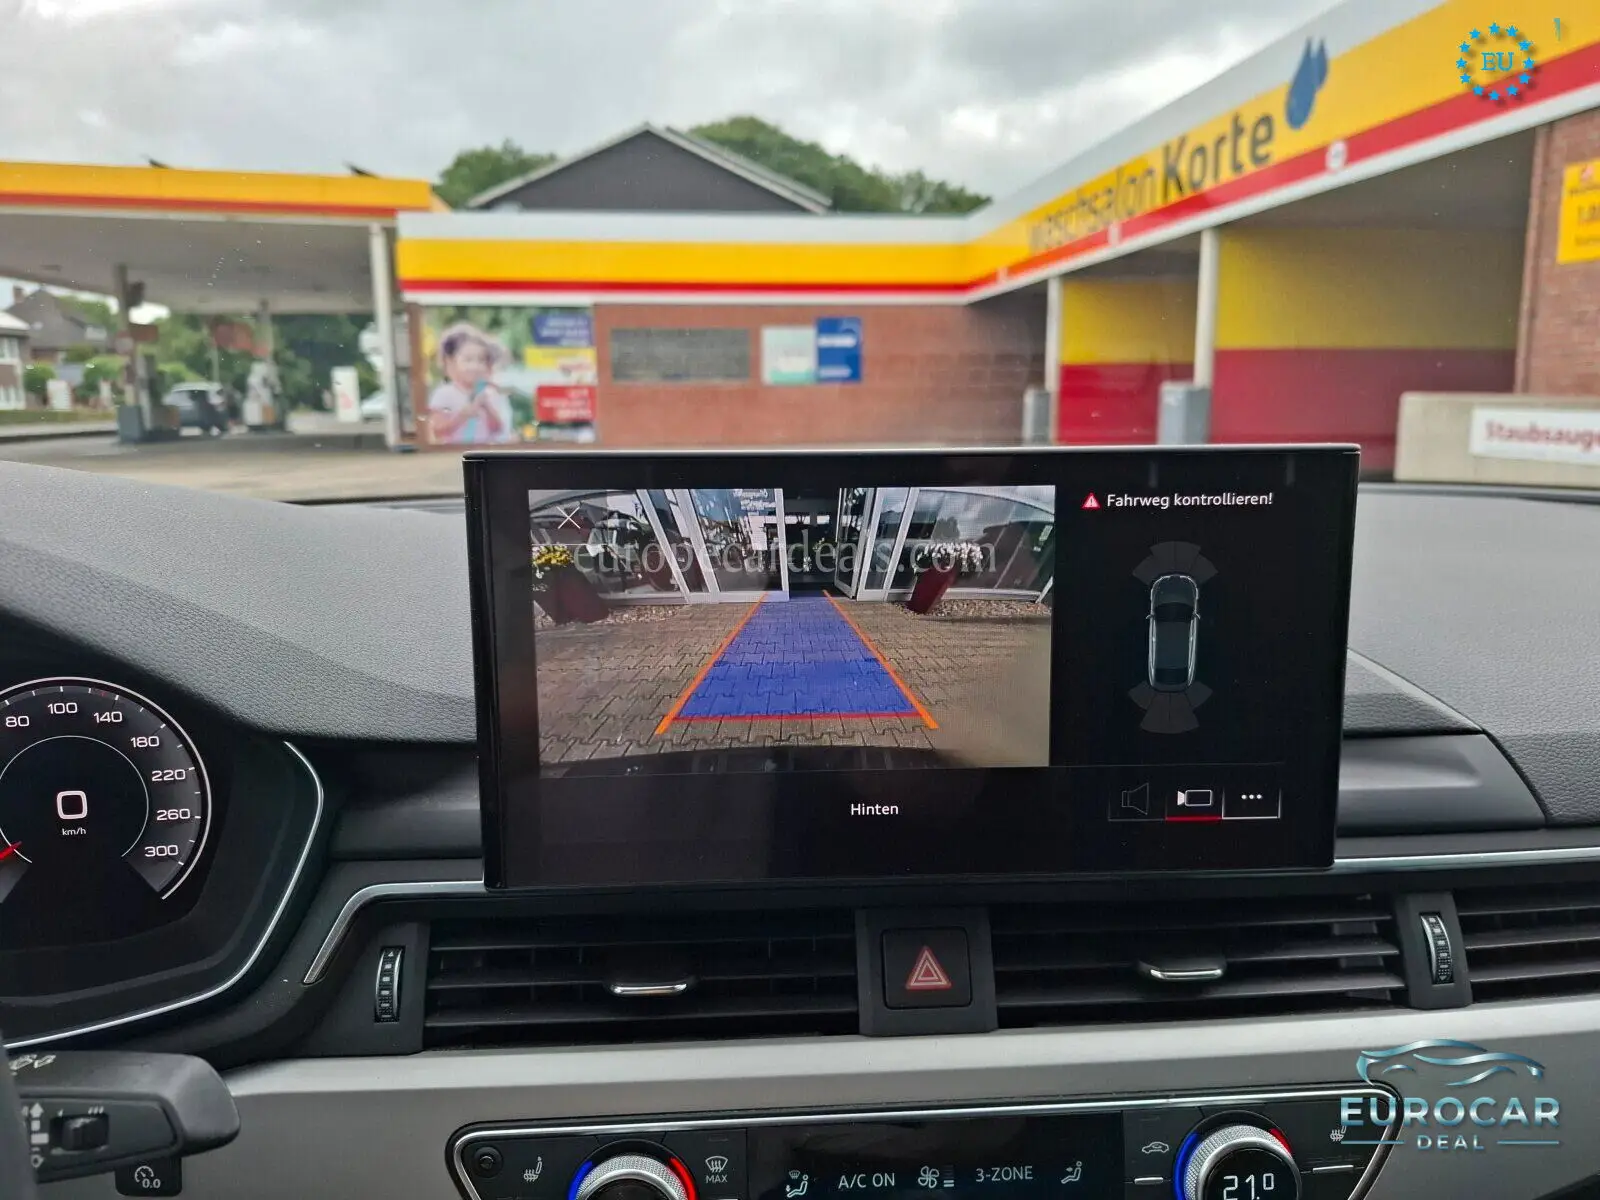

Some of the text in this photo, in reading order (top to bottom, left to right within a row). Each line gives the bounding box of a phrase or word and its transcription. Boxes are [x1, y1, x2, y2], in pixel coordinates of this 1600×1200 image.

[1162, 112, 1275, 206] Korte
[1107, 493, 1273, 509] Fahrweg kontrollieren!
[48, 702, 77, 715] 100
[5, 715, 30, 727] 80
[94, 711, 123, 723] 140
[130, 736, 160, 748] 180
[151, 769, 186, 782] 220
[56, 790, 88, 820] 0
[850, 803, 899, 816] Hinten
[156, 808, 191, 821] 260
[61, 827, 87, 836] km/h
[144, 845, 179, 857] 300
[705, 1174, 729, 1184] MAX
[975, 1165, 1034, 1182] 3-ZONE
[142, 1178, 161, 1189] 0.0
[837, 1172, 896, 1189] A/C ON
